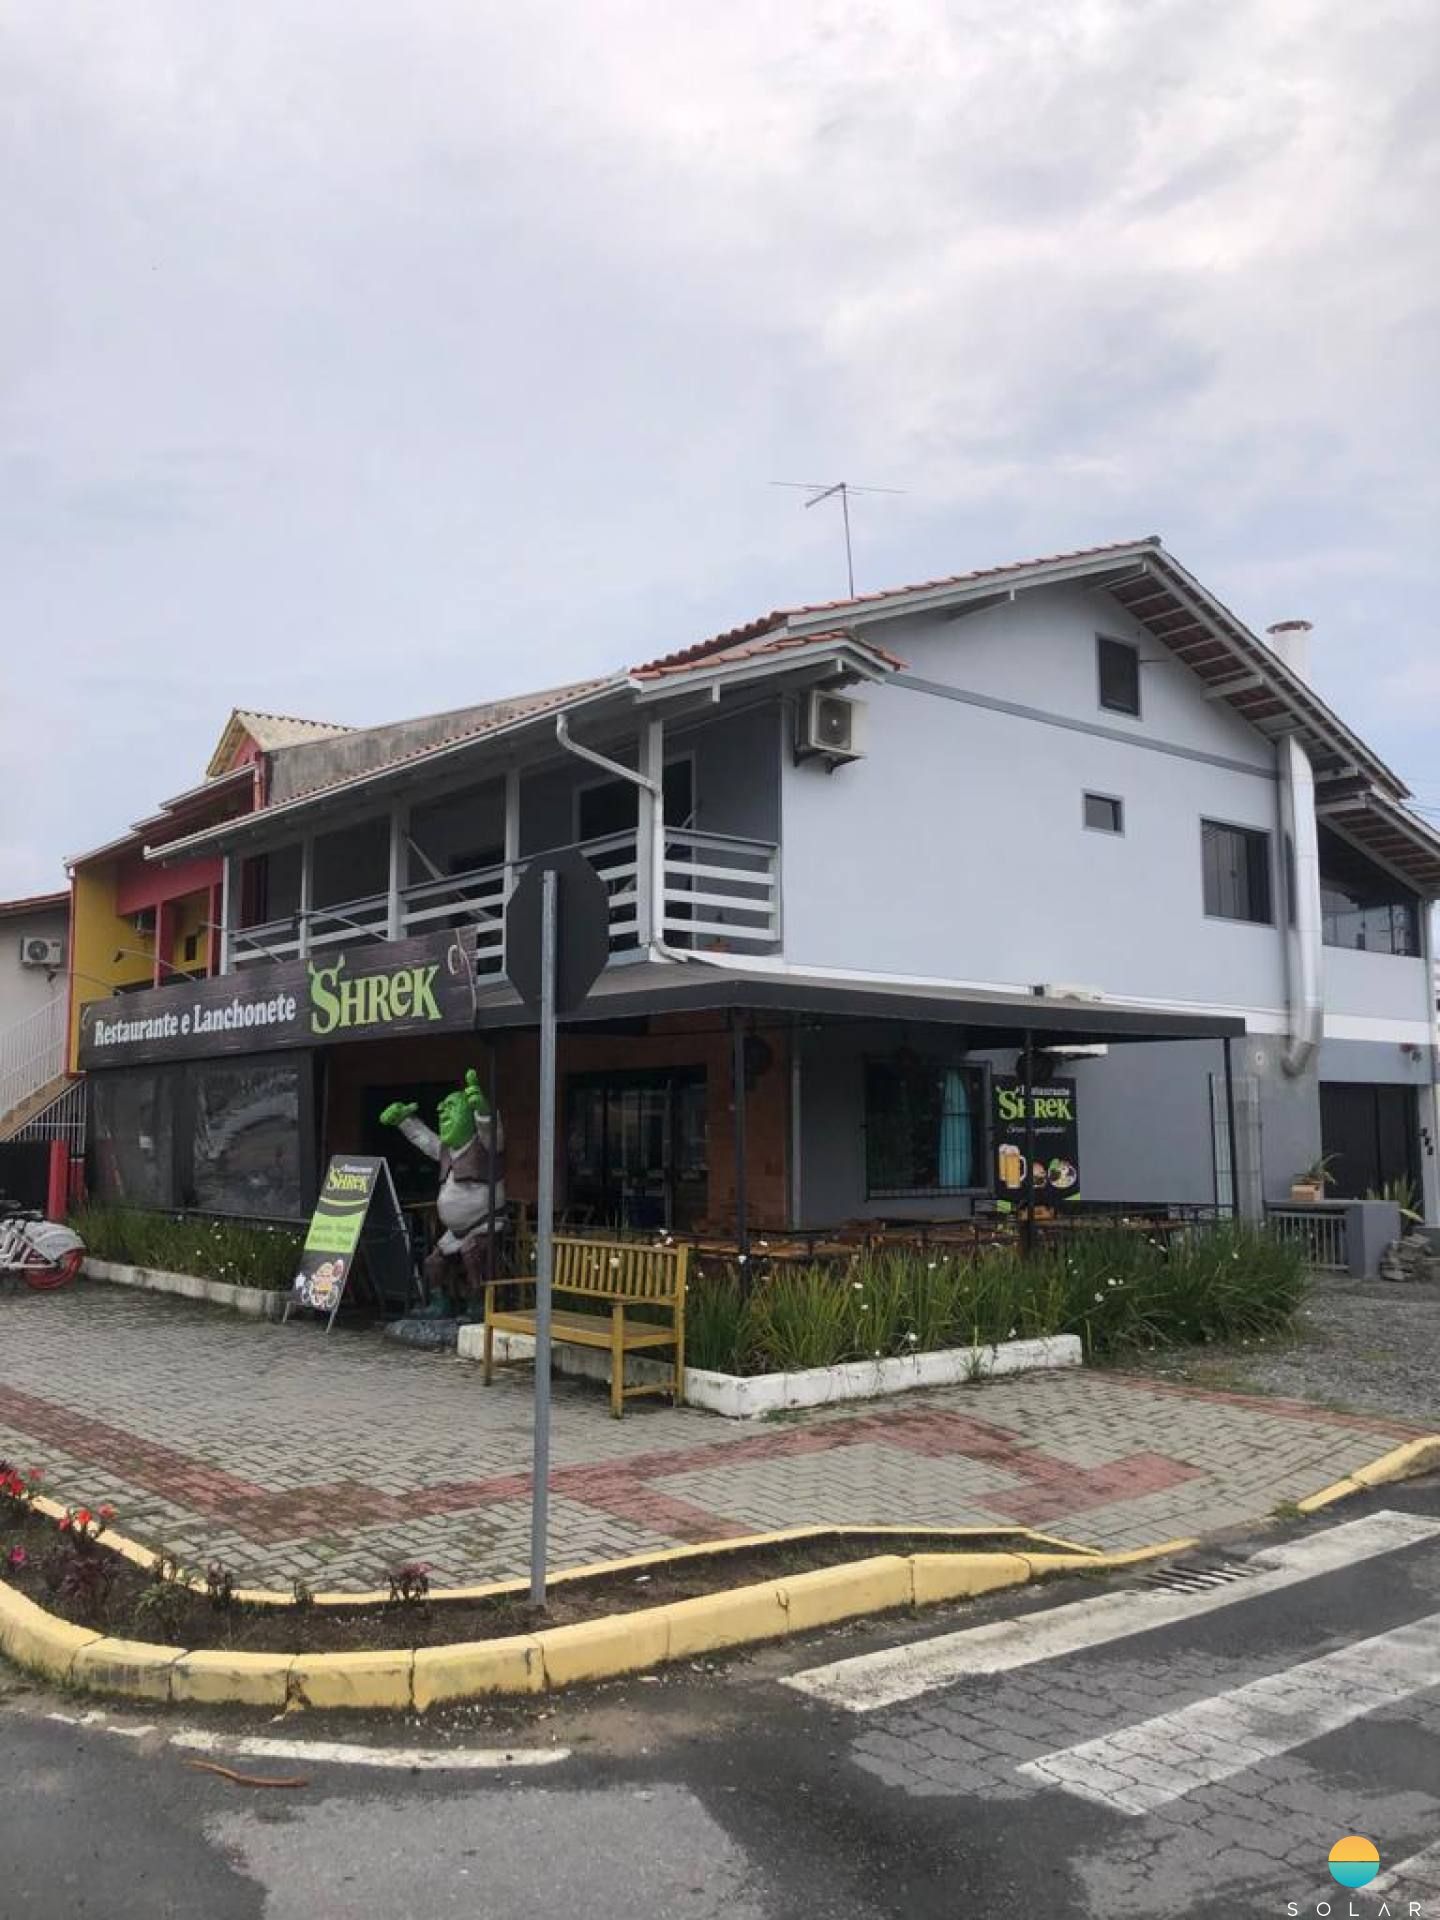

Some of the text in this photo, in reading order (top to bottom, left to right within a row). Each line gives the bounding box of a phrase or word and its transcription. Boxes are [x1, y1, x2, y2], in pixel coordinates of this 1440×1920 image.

[94, 993, 296, 1047] Restaurante e Lanchonete
